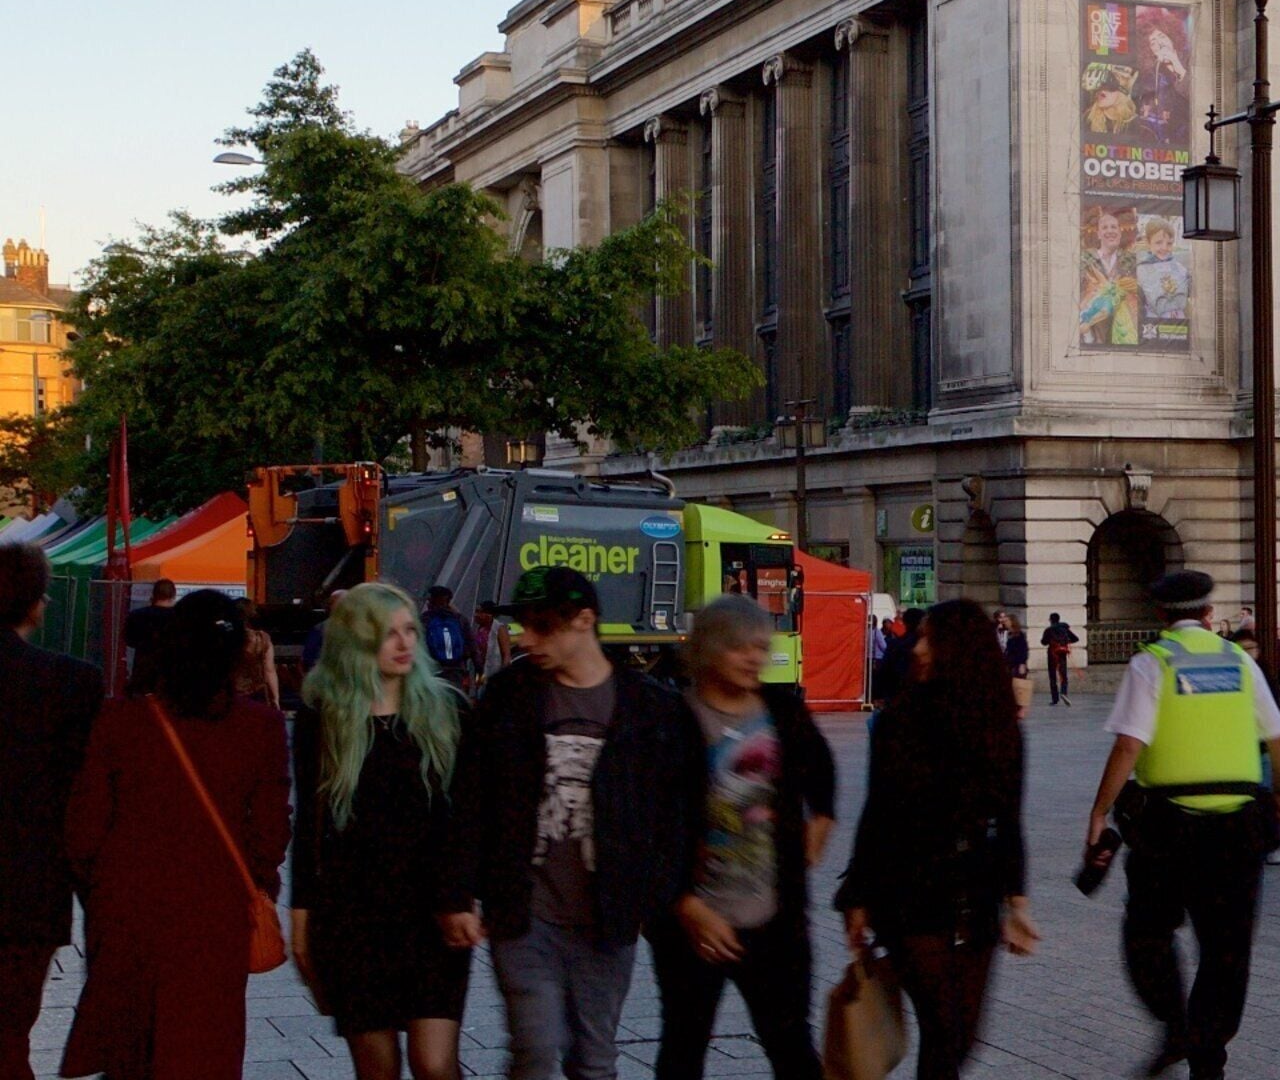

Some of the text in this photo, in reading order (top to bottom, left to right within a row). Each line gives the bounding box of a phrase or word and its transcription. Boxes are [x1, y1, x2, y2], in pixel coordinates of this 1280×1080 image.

[1090, 10, 1122, 25] ONE
[1084, 143, 1189, 164] NOTTINGHAM
[519, 535, 640, 575] cleaner
